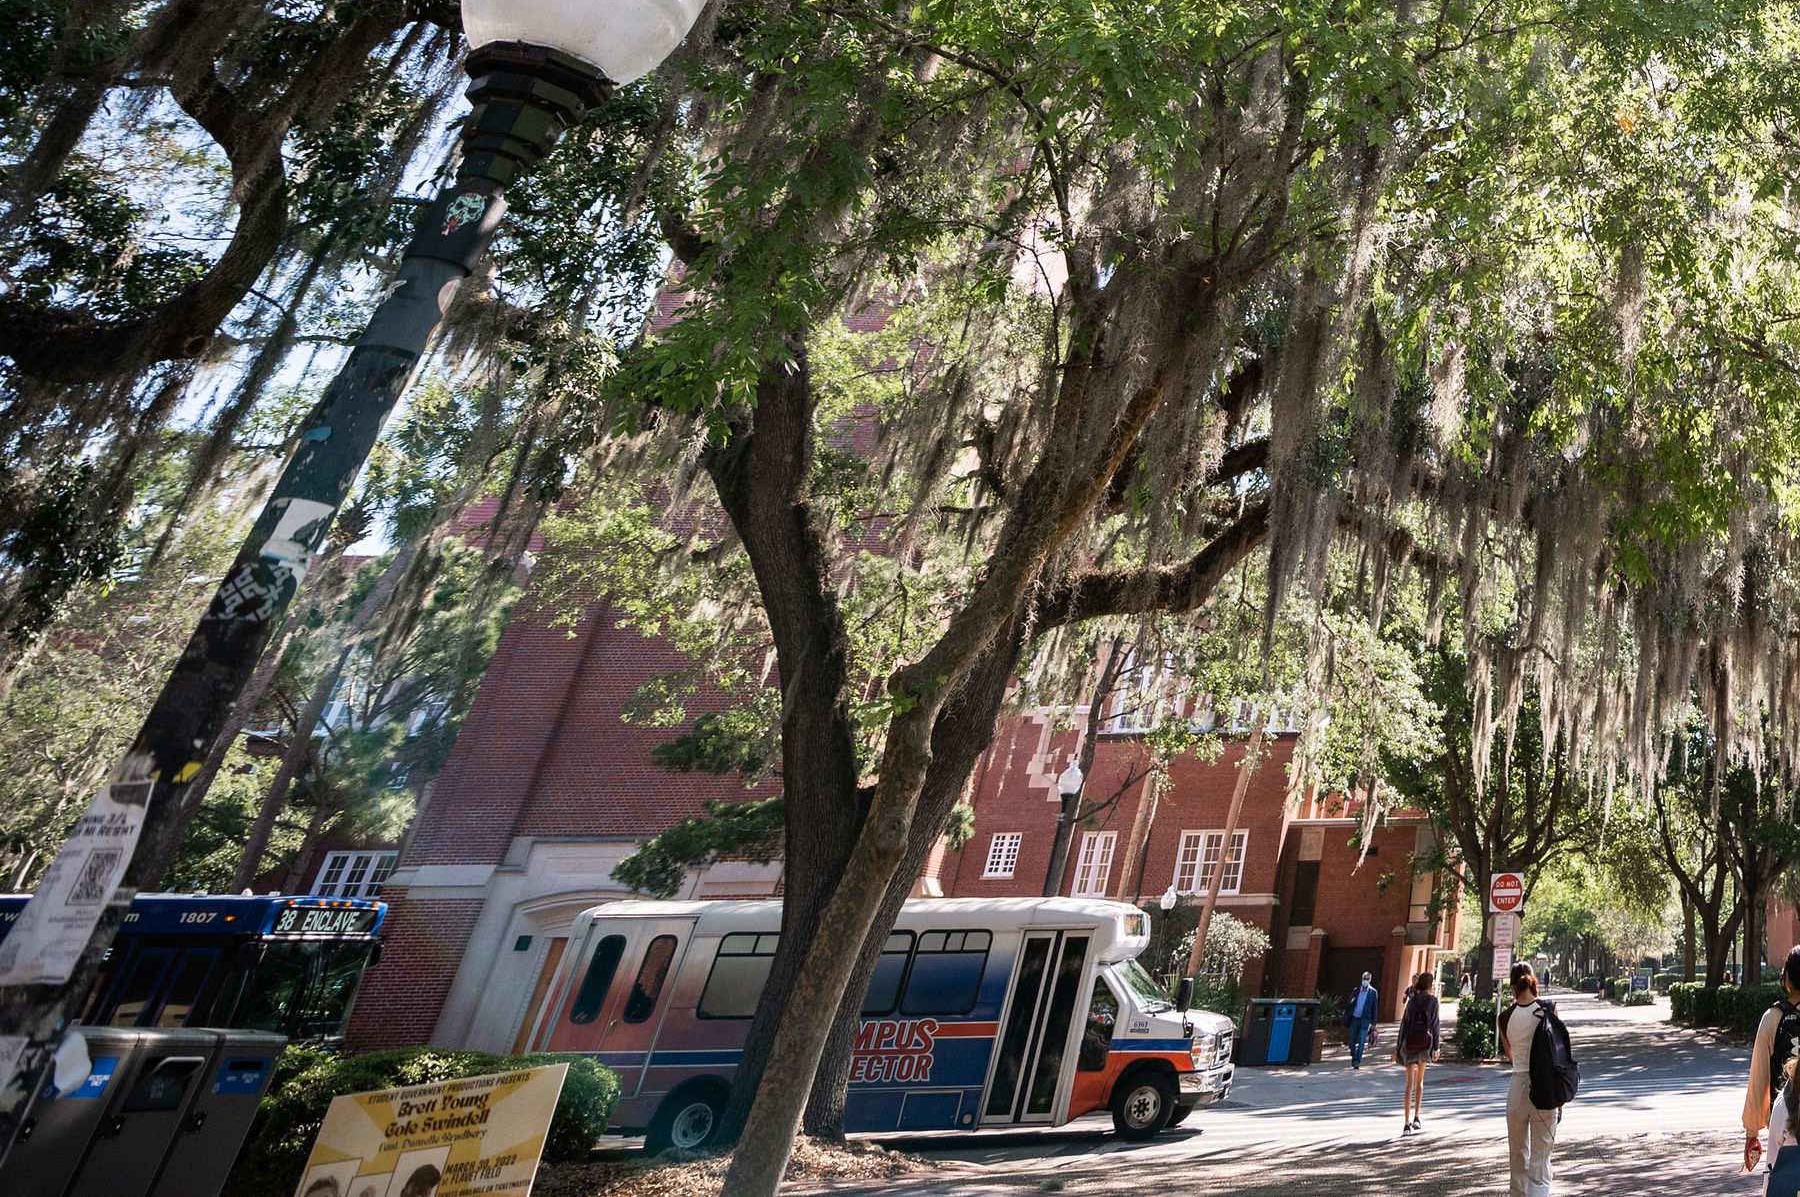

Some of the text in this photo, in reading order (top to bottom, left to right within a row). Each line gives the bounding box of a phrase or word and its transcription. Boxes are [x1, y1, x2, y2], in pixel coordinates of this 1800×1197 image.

[180, 912, 217, 923] 1807
[277, 910, 360, 931] 38 ENCLAVE
[853, 1018, 939, 1055] MPUS
[850, 1054, 934, 1082] ECTOR
[368, 1072, 531, 1104] STUDENT GOVERNMENT PRODUCTIONS PRESENTS
[398, 1091, 490, 1118] Brett Young
[422, 1109, 490, 1132] Swindell
[445, 1160, 476, 1174] MARCH
[495, 1154, 518, 1168] 2022
[480, 1166, 502, 1180] FIELD
